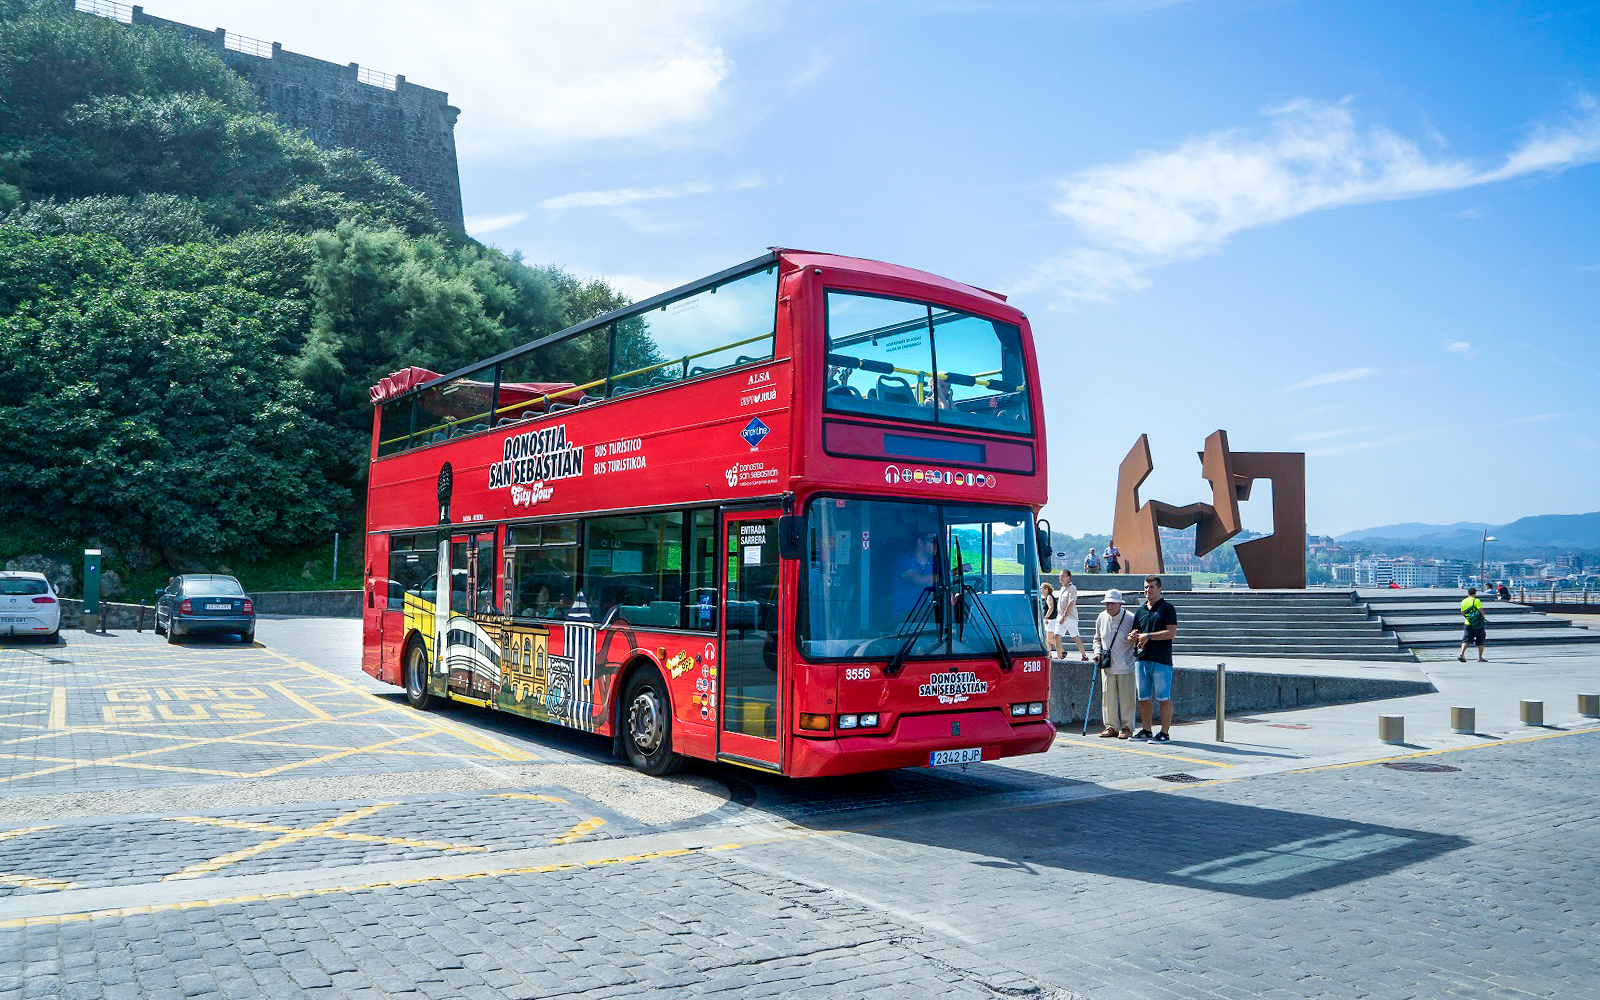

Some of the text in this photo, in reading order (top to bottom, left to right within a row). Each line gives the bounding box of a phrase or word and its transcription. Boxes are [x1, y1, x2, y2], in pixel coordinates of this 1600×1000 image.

[748, 371, 770, 385] ALSA
[503, 424, 566, 462] DONOSTIA
[595, 438, 641, 457] BUS TURÍSTICO
[489, 441, 584, 490] SAN SEBASTIÁN
[594, 455, 646, 475] BUS TURISTIKOA
[511, 481, 555, 508] City Tour
[741, 525, 766, 535] ENTRADA
[741, 535, 767, 545] SARRERA
[845, 668, 871, 680] 3556
[1023, 661, 1041, 672] 2508
[930, 672, 976, 685] DONOSTIA
[919, 679, 987, 696] SAN SEBASTIÁN
[102, 703, 266, 722] BUS
[936, 749, 980, 764] 2342 BJP
